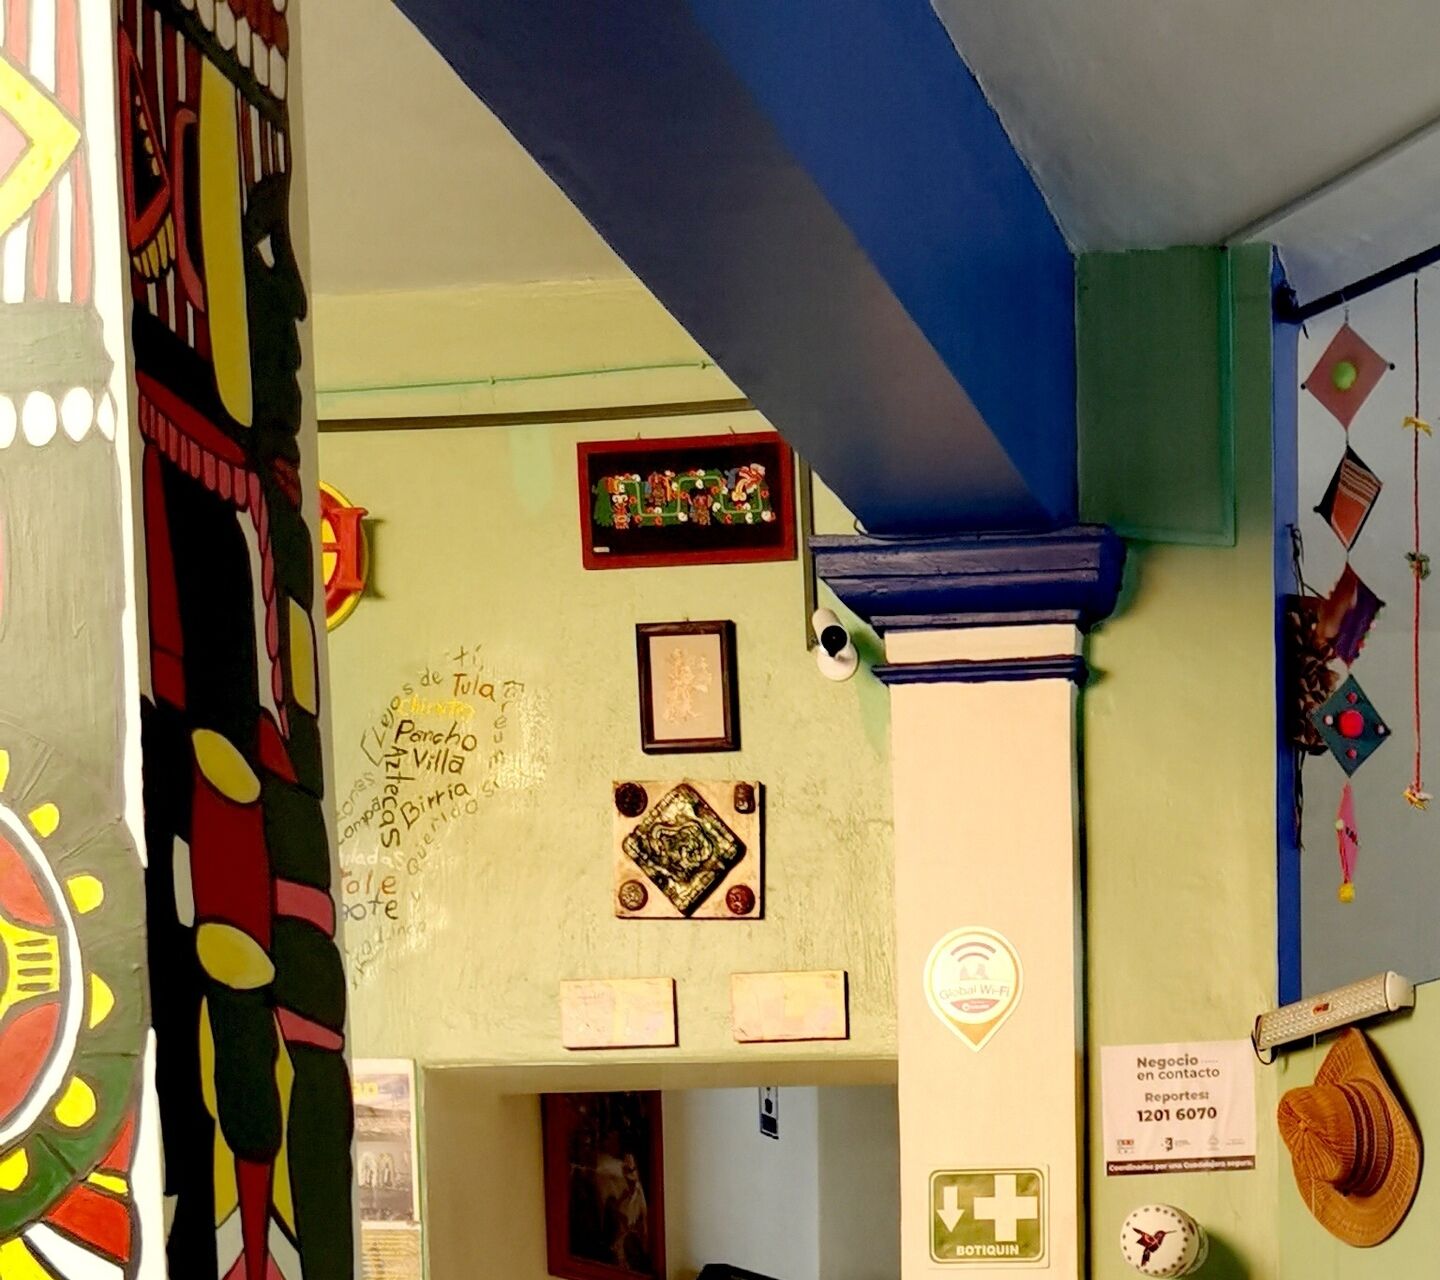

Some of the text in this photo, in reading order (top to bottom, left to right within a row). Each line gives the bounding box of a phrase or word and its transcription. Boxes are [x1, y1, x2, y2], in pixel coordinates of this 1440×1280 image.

[453, 672, 496, 703] Tula
[394, 719, 478, 752] Pancho
[413, 748, 466, 776] Villa
[379, 745, 416, 849] Aztecas
[400, 782, 471, 831] Birria
[1137, 1053, 1199, 1069] Negocio
[1137, 1067, 1220, 1081] en contacto
[1145, 1090, 1210, 1104] Reportes:
[1137, 1106, 1218, 1122] 1201 6070
[956, 1243, 1020, 1257] BOTIQUIN
